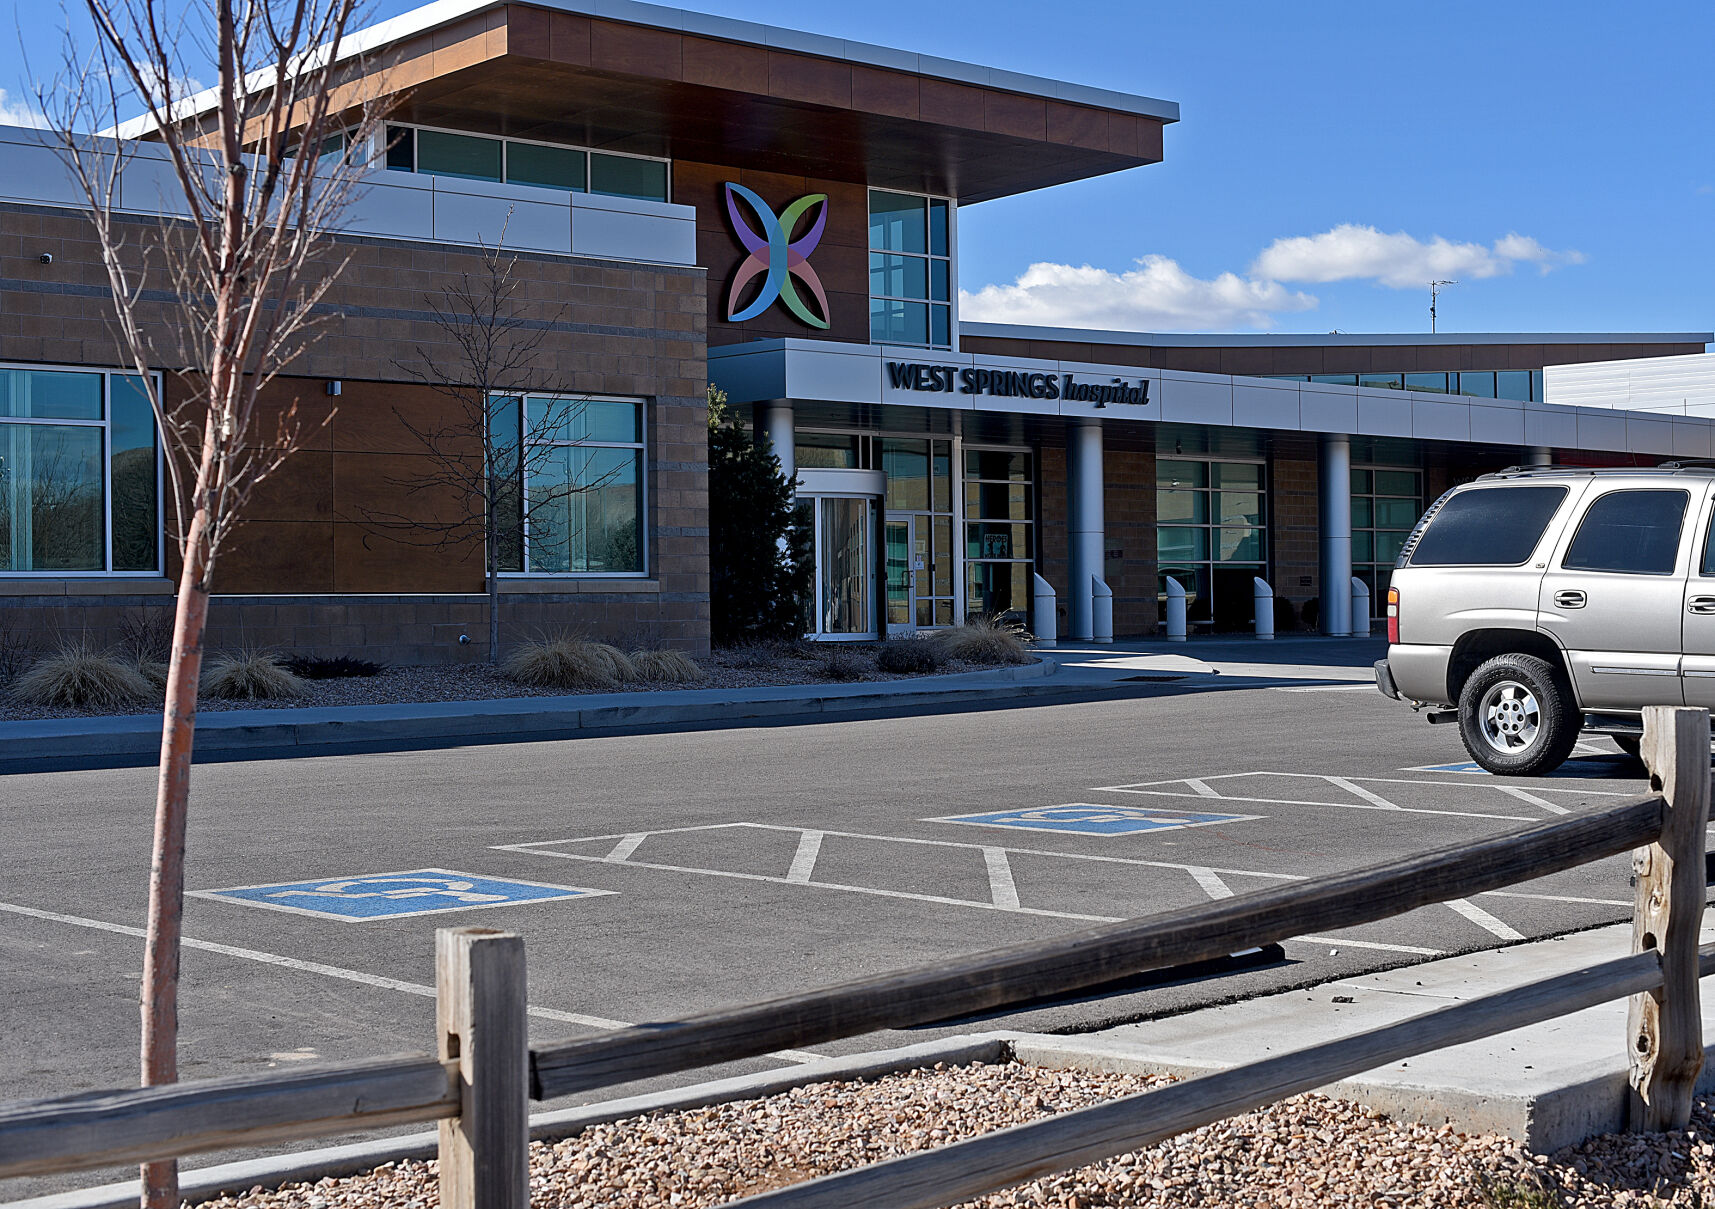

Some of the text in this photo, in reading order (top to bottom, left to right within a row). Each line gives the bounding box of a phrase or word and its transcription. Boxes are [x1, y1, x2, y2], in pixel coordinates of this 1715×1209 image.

[888, 362, 1150, 408] WEST SPRINGS hospital
